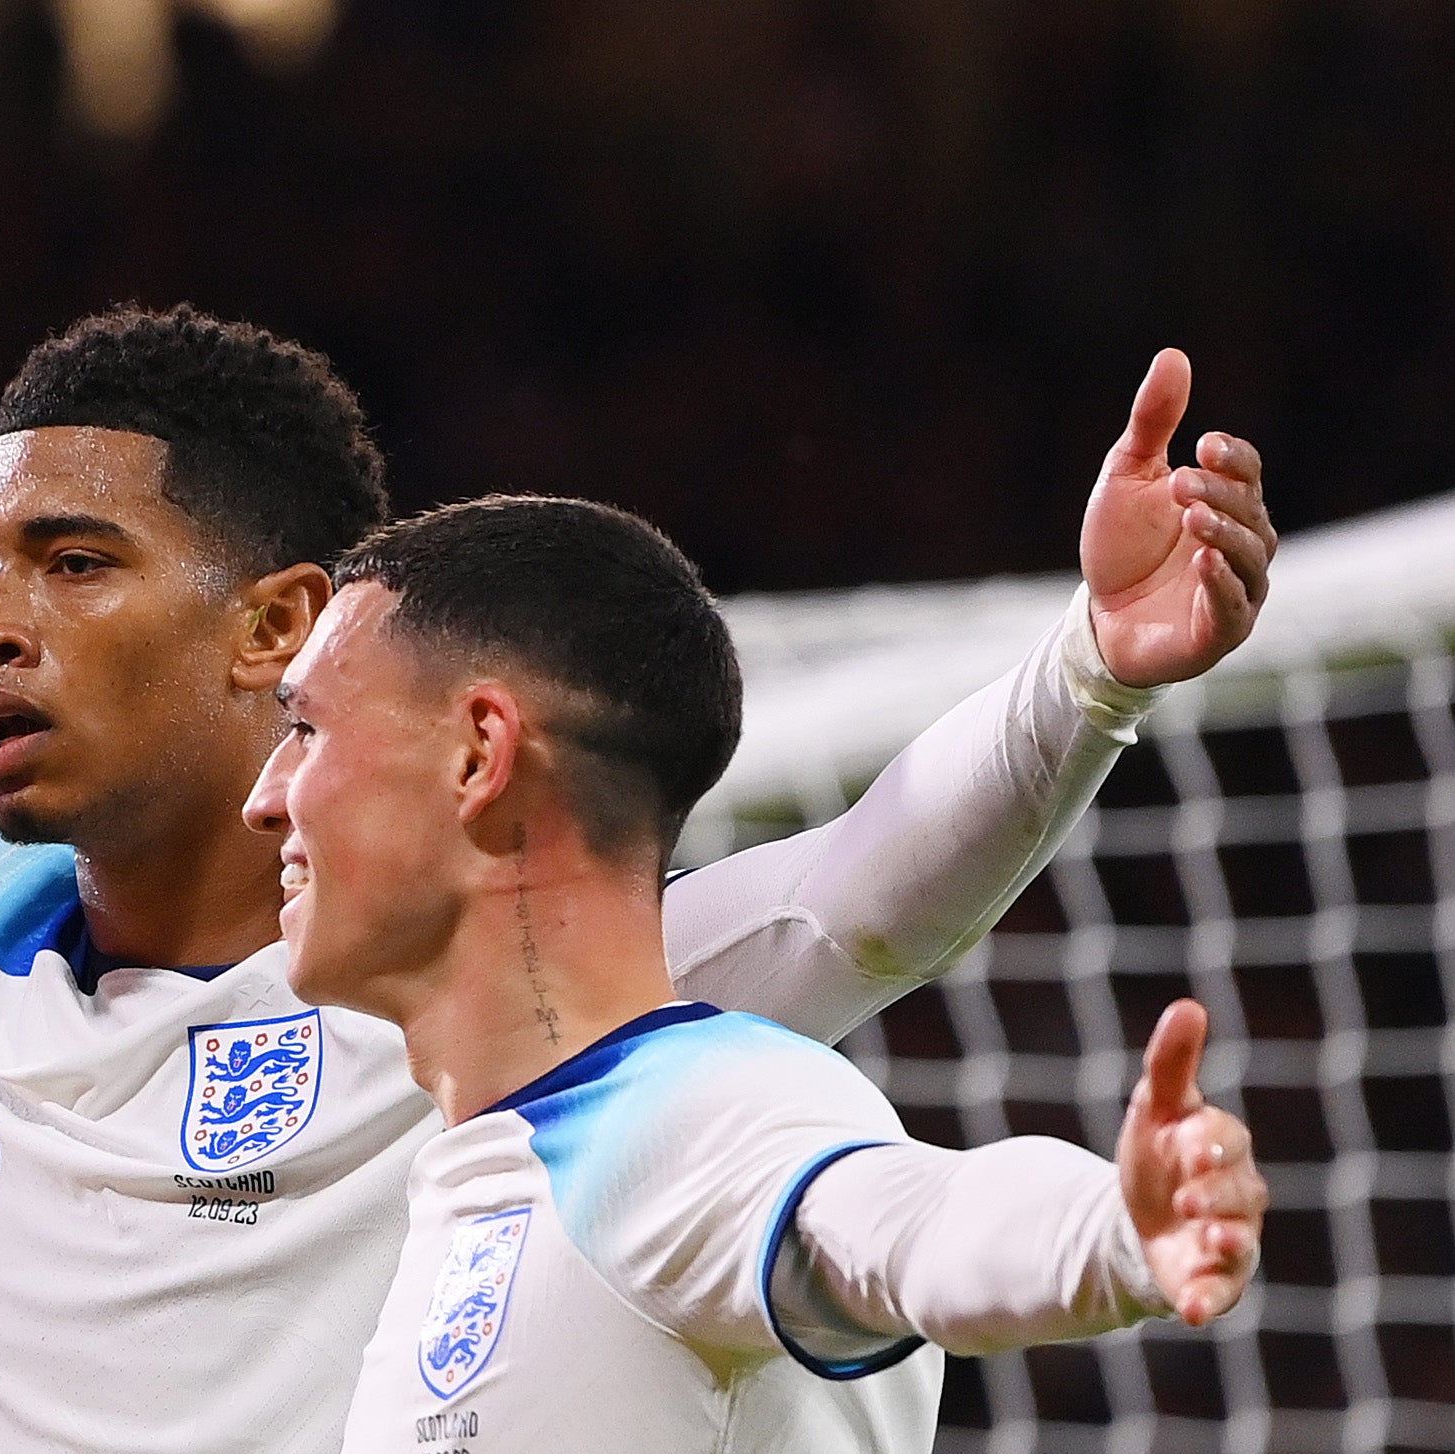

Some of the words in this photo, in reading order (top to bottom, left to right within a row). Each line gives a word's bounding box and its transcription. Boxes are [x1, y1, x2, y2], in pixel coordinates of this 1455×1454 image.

[173, 1169, 275, 1195] SCOTLAND
[187, 1194, 260, 1226] 12.09.23
[415, 1410, 479, 1444] SCOTLAND
